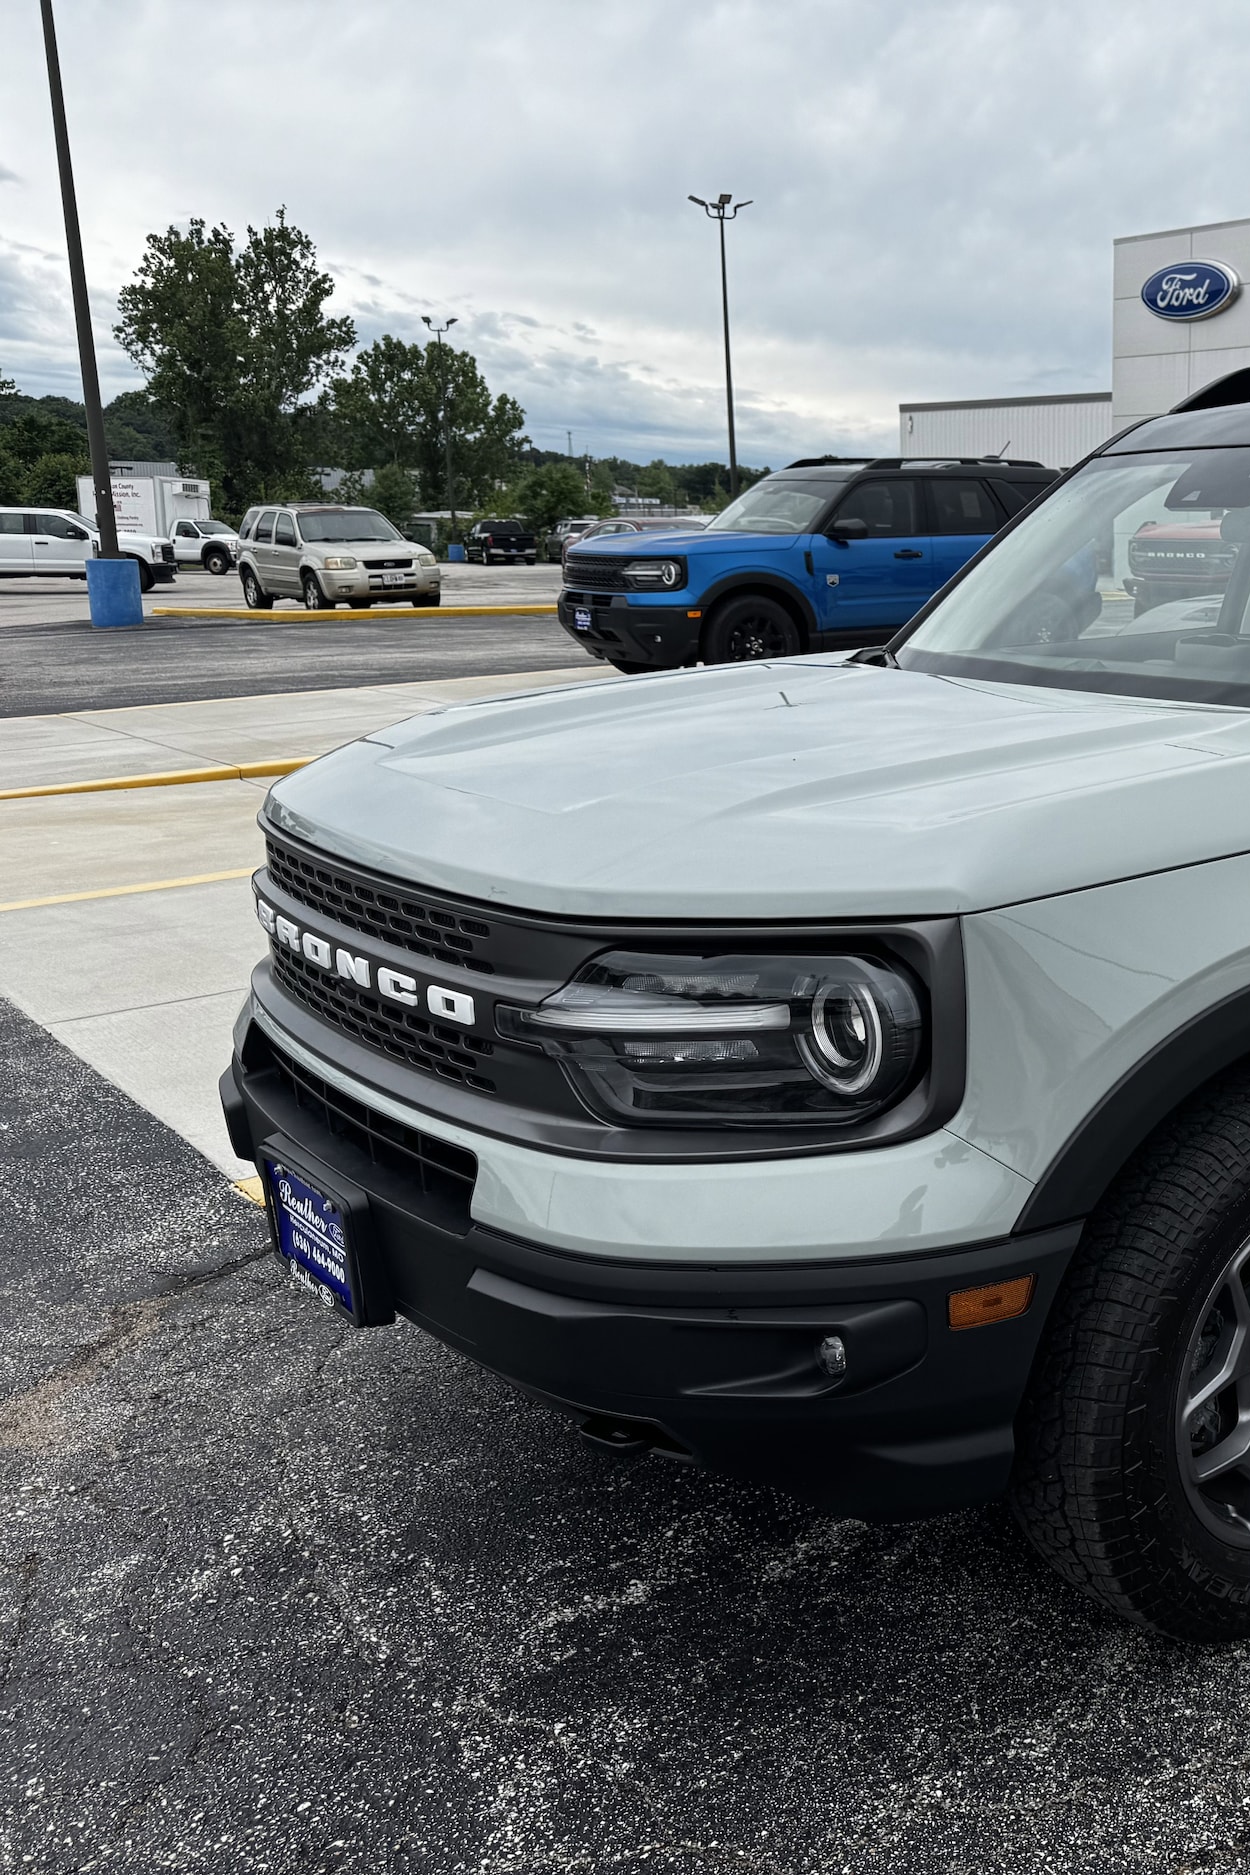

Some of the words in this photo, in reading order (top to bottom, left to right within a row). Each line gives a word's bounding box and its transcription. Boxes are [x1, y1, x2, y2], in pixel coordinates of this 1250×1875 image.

[1156, 273, 1210, 308] Ford
[258, 898, 477, 1026] BRONCO
[278, 1179, 328, 1234] Reuther
[292, 1229, 311, 1260] (636)
[290, 1258, 319, 1297] Reuther
